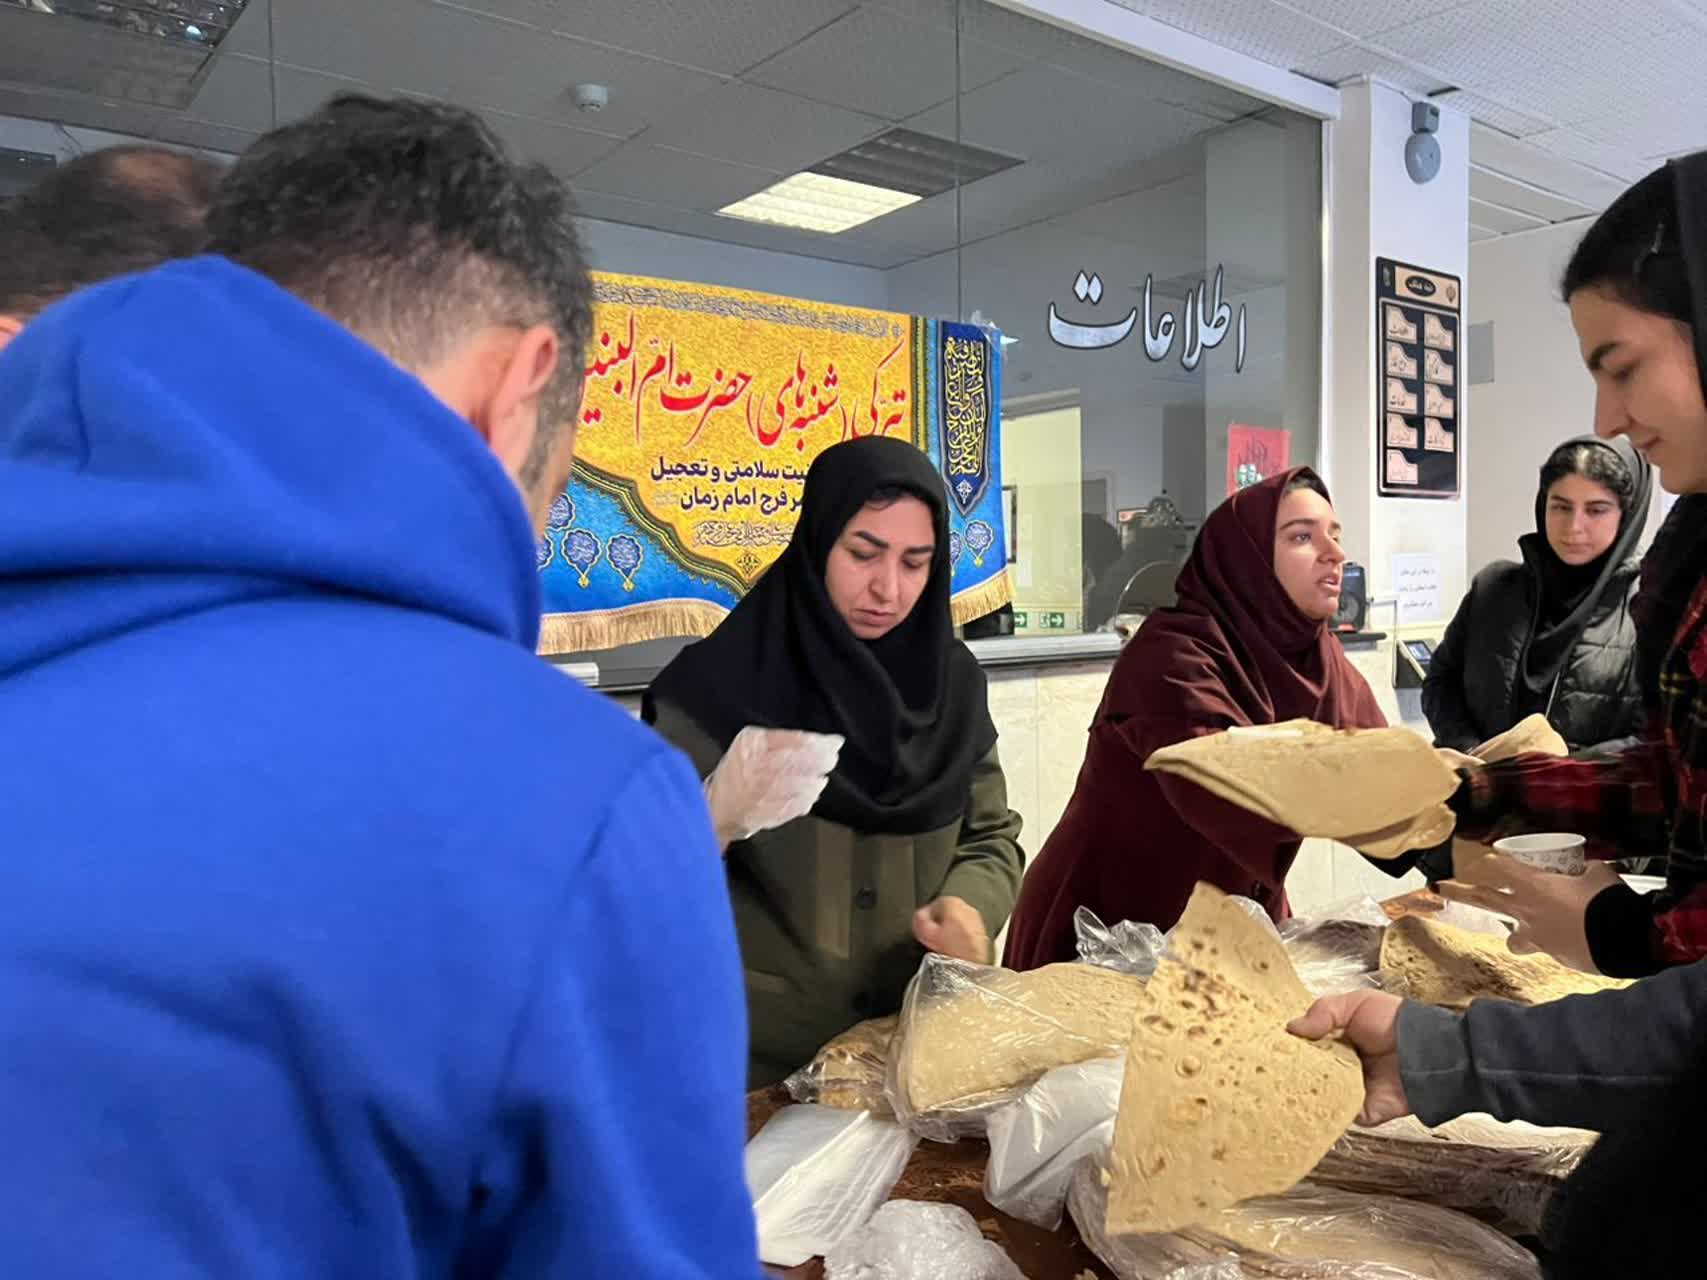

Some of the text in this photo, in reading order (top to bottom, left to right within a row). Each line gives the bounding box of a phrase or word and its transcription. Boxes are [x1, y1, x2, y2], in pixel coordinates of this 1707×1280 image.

[1049, 263, 1247, 374] اطلاعات
[575, 310, 636, 424] البنی
[660, 367, 753, 448] حضرت
[651, 456, 709, 482] تعجیل
[711, 466, 721, 483] و
[724, 460, 779, 483] سلامتی
[680, 486, 719, 511] زمان
[723, 486, 757, 512] امام
[760, 485, 788, 515] فرج
